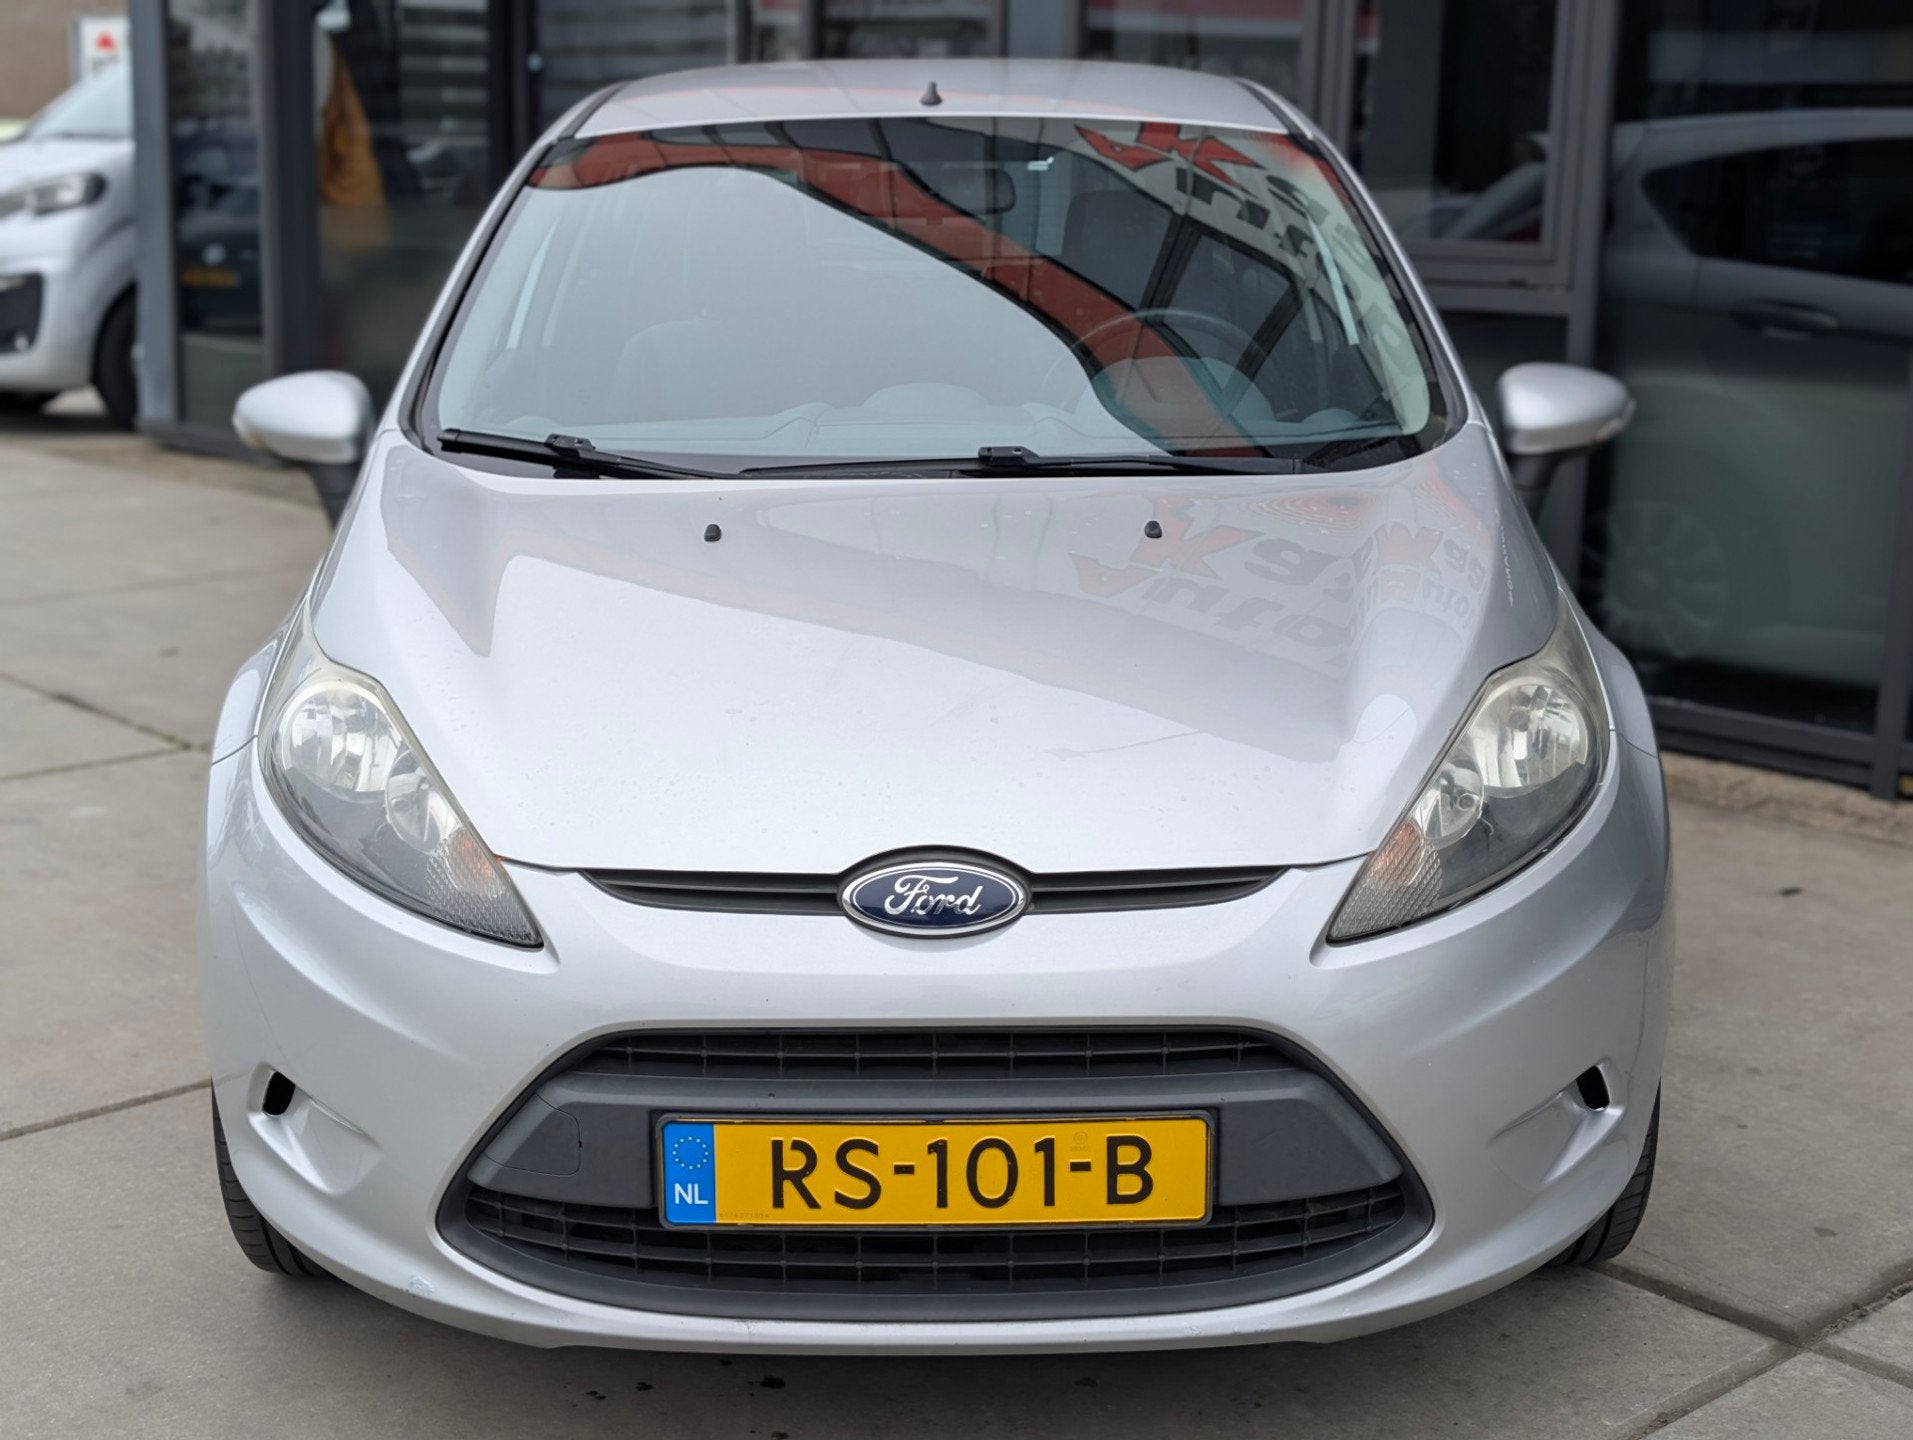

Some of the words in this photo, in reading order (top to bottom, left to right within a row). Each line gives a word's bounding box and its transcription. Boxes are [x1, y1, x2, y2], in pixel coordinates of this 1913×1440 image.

[884, 874, 983, 915] Ford
[770, 1134, 1154, 1211] RS-101-B
[674, 1183, 709, 1205] NL
